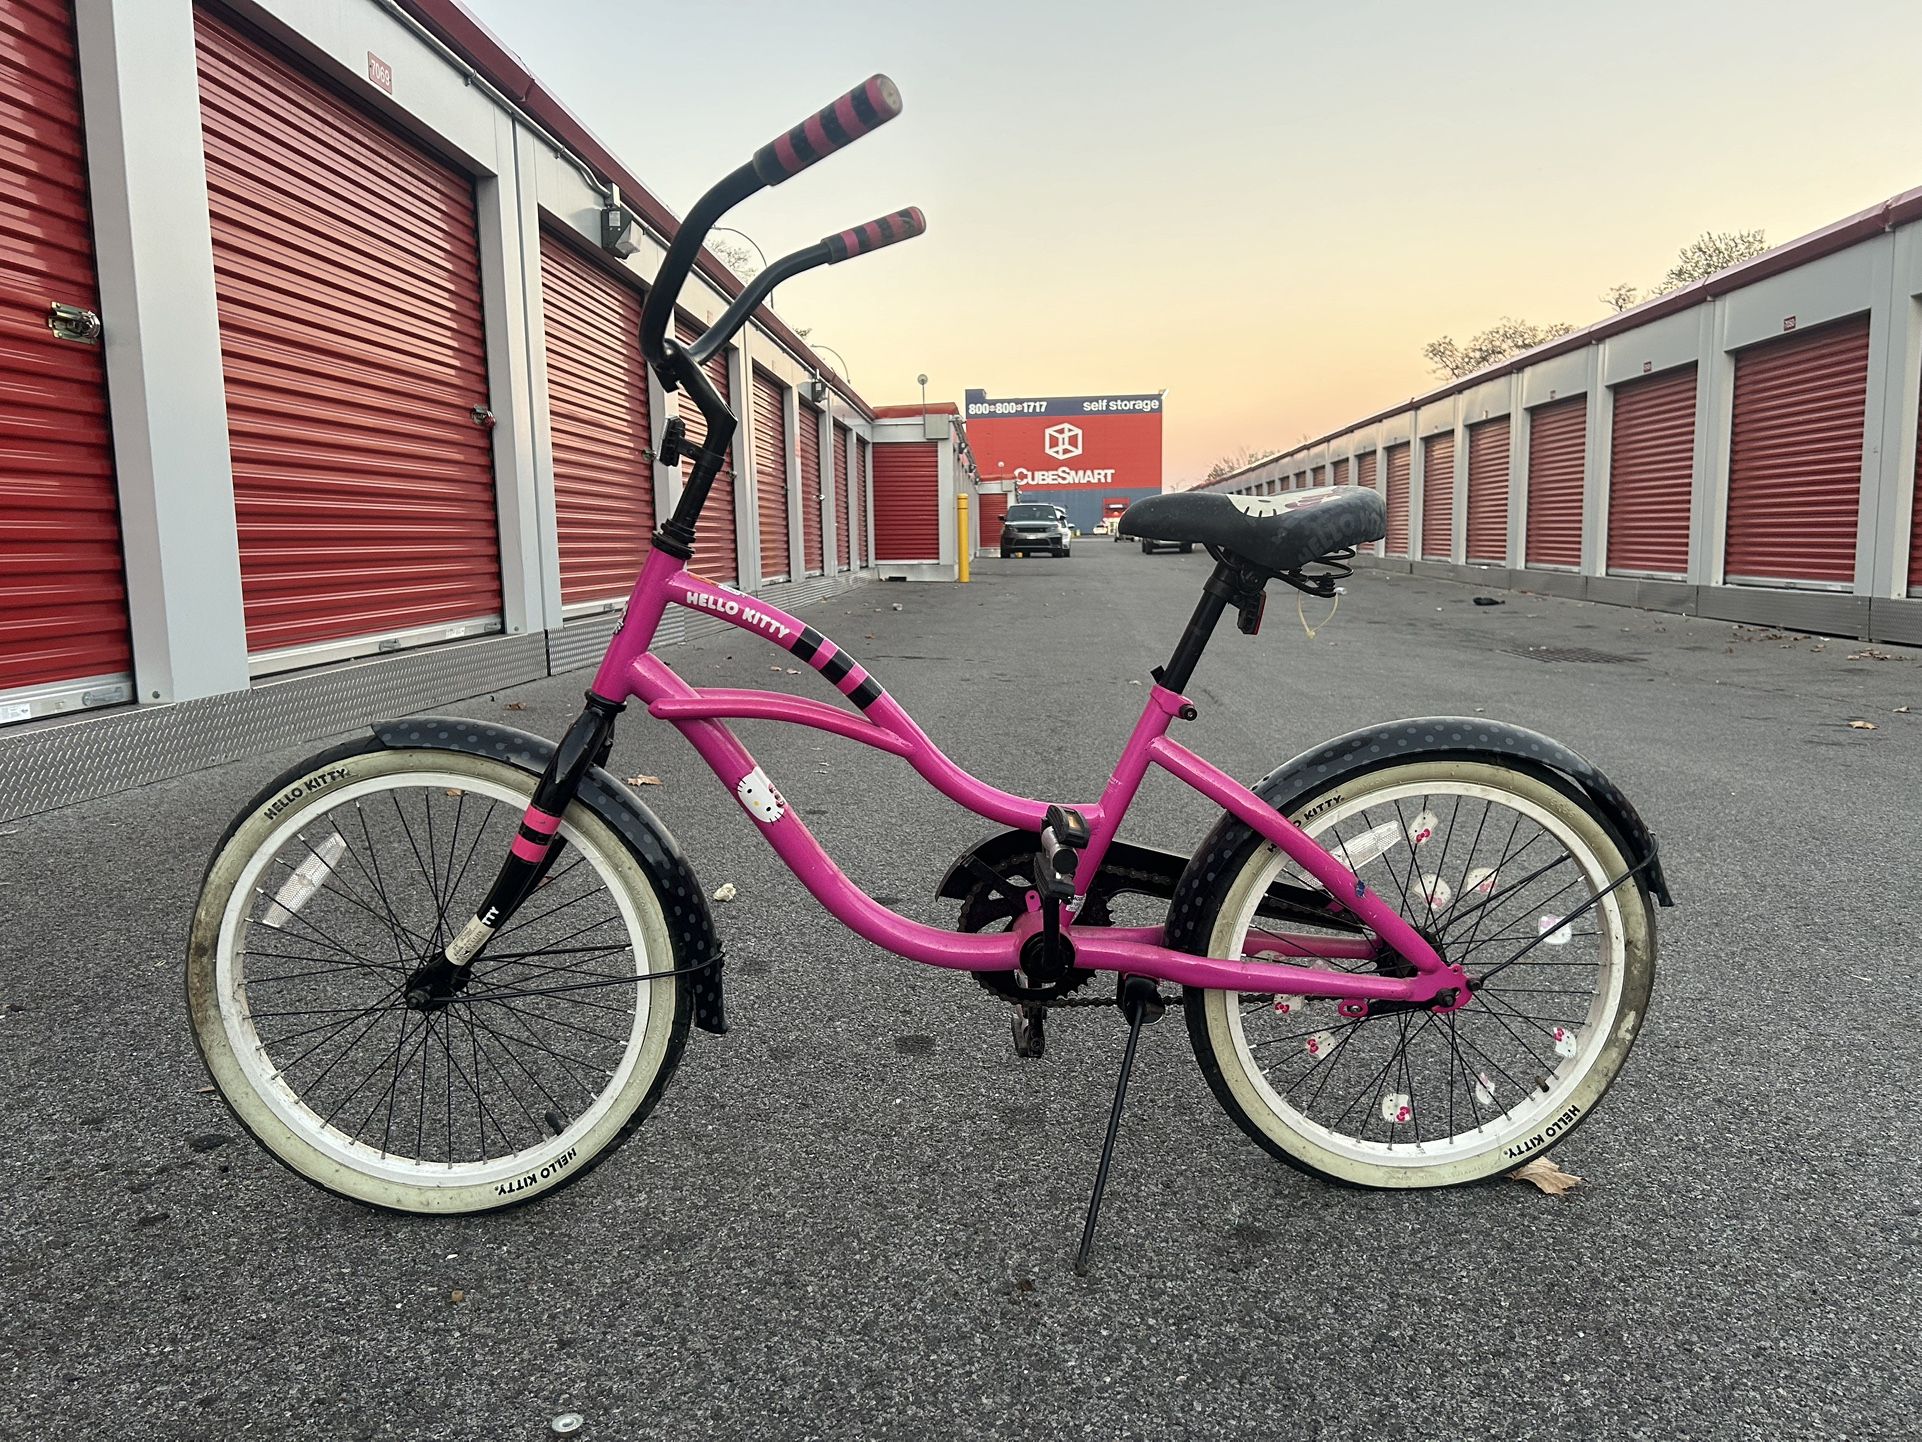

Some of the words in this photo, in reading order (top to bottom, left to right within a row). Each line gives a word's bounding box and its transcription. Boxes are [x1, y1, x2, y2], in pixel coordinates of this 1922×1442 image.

[371, 59, 390, 86] 7069
[1083, 399, 1108, 411] self
[1109, 399, 1159, 412] storage
[686, 591, 739, 615] HELLO
[741, 607, 791, 639] KITTY
[263, 787, 303, 820] HELLO
[1545, 1104, 1581, 1137] HELLO
[541, 1147, 577, 1179] HELLO
